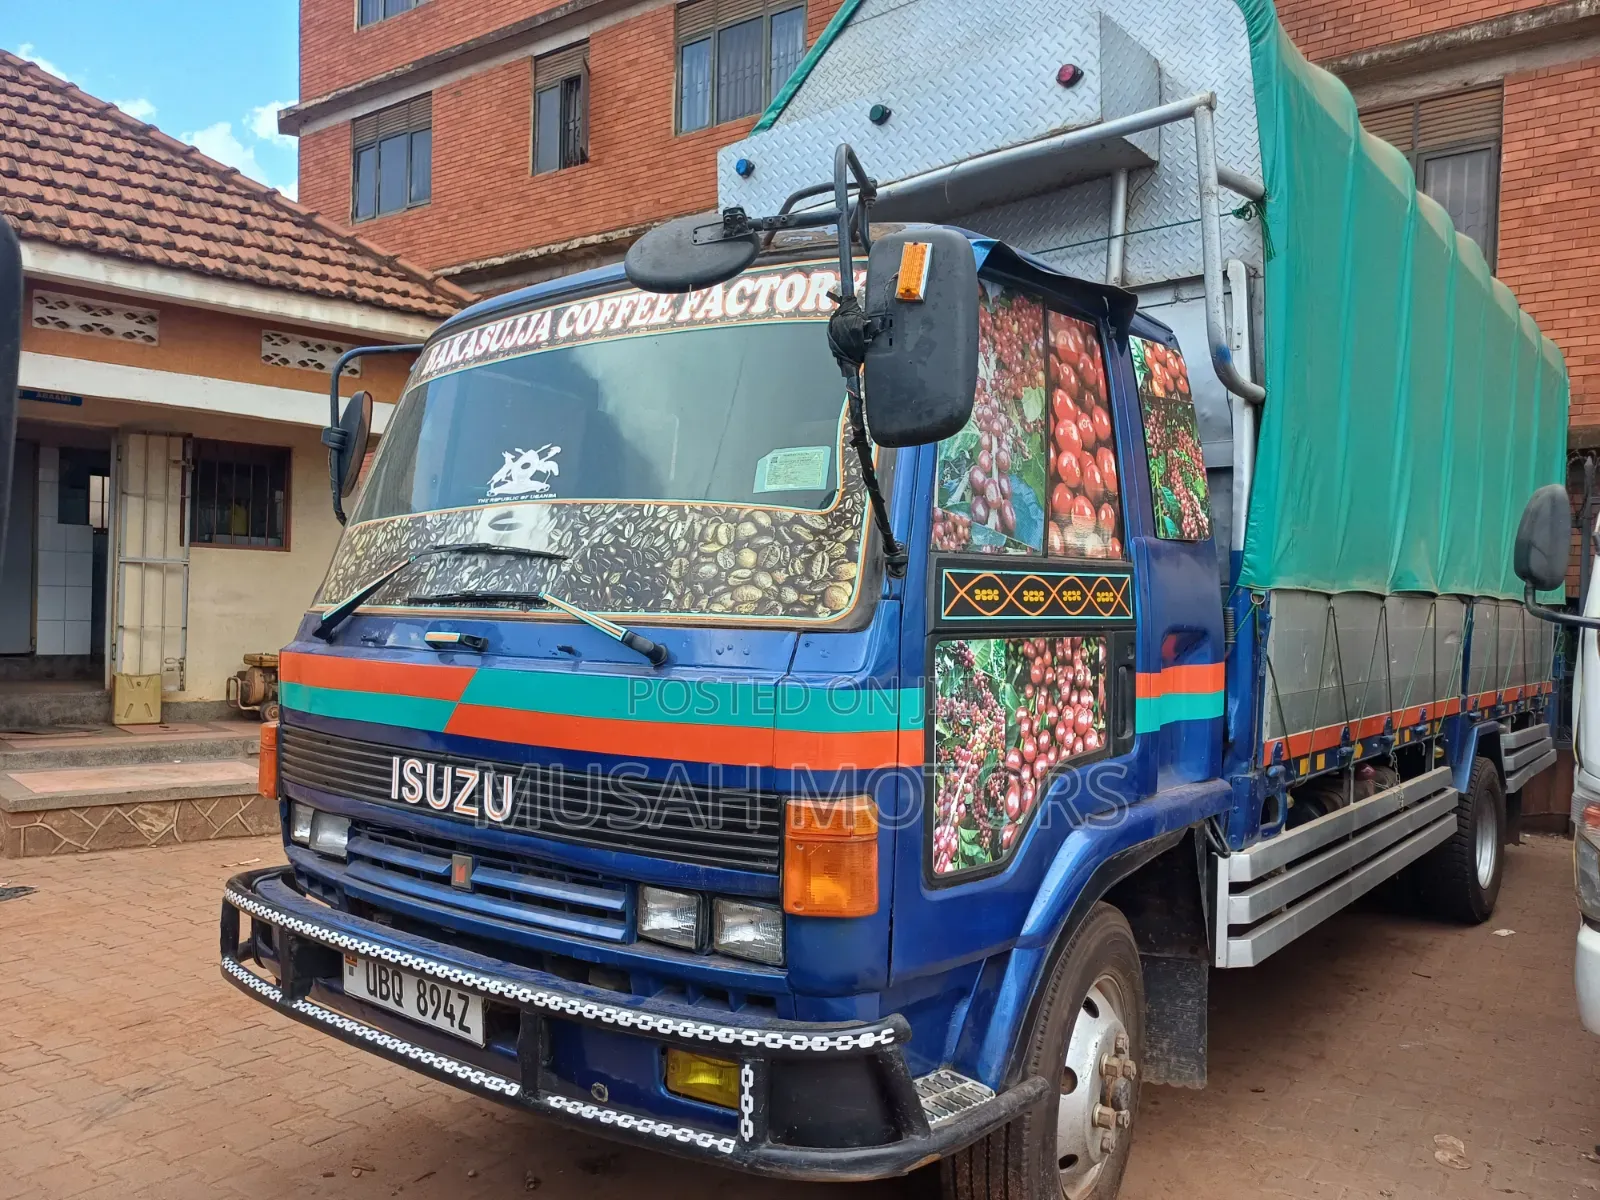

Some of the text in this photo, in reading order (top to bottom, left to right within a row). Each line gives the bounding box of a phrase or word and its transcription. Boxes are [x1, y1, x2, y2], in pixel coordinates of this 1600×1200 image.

[557, 290, 678, 337] COFFEE
[391, 756, 514, 822] ISUZU
[365, 960, 472, 1035] UBQ 894Z
